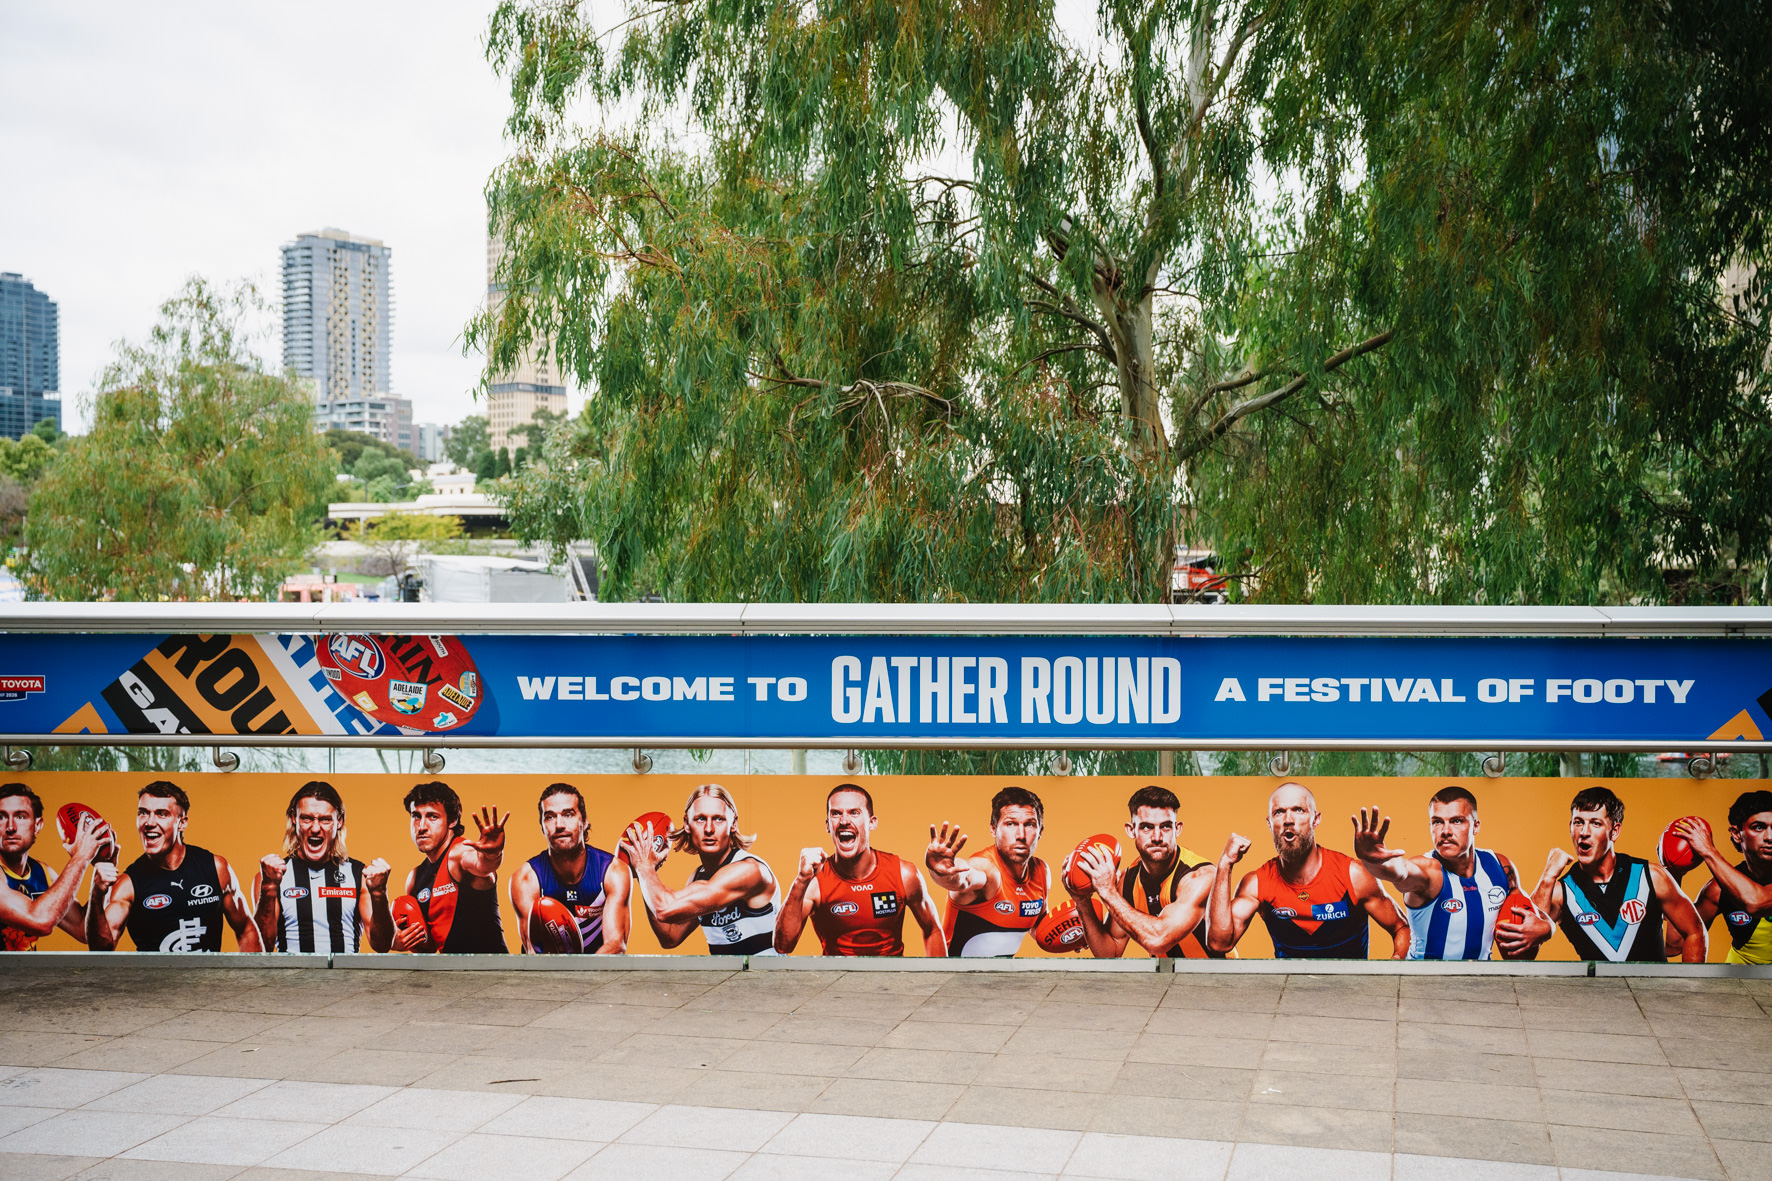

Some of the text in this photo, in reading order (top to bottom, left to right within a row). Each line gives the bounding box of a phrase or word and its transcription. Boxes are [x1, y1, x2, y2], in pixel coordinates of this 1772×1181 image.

[331, 635, 377, 678] AFL
[1, 679, 42, 689] TOYOTA
[157, 635, 298, 734] ROU
[393, 682, 424, 696] ADELAIDE
[517, 655, 1696, 725] WELCOME TO GATHER ROUND A FESTIVAL OF FOOTY
[119, 670, 192, 734] GA
[441, 685, 473, 711] ADELAIDE
[285, 889, 307, 897] AFL
[321, 887, 354, 897] Emirates
[146, 896, 170, 907] AFL
[187, 895, 220, 907] HYUNDAI
[1443, 901, 1462, 909] AFL
[833, 904, 857, 913] AFL
[995, 903, 1014, 912] AFL
[1621, 900, 1645, 923] MG
[711, 906, 741, 926] Ford
[1315, 910, 1347, 921] ZURICH
[1578, 914, 1600, 923] AFL
[1730, 914, 1751, 922] AFL
[1063, 929, 1082, 943] AFL
